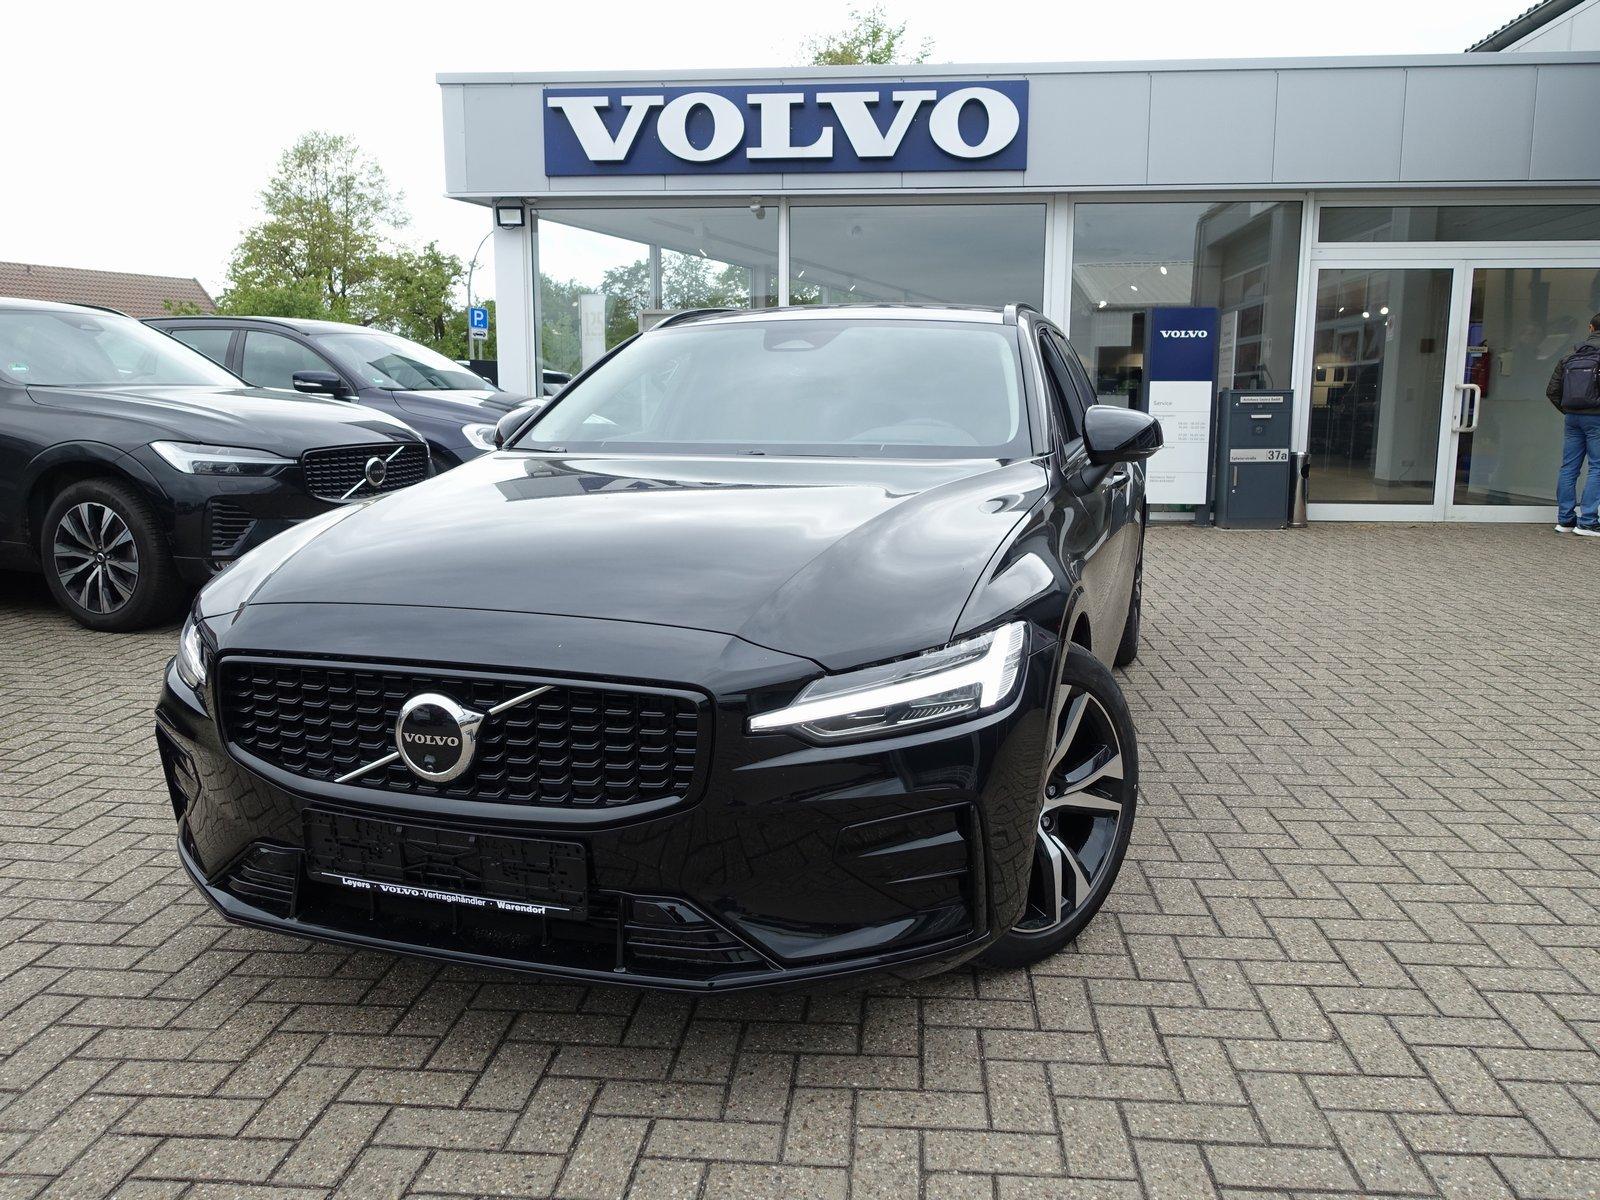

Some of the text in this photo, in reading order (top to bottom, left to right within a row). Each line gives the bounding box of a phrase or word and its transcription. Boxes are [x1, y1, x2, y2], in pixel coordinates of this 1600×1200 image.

[547, 87, 1020, 162] VOLVO
[474, 310, 484, 326] P
[1160, 330, 1208, 338] VOLVO
[1268, 450, 1287, 460] 37a
[403, 732, 459, 747] VOLVO
[342, 877, 371, 889] Leyers
[497, 901, 546, 915] Warendorf
